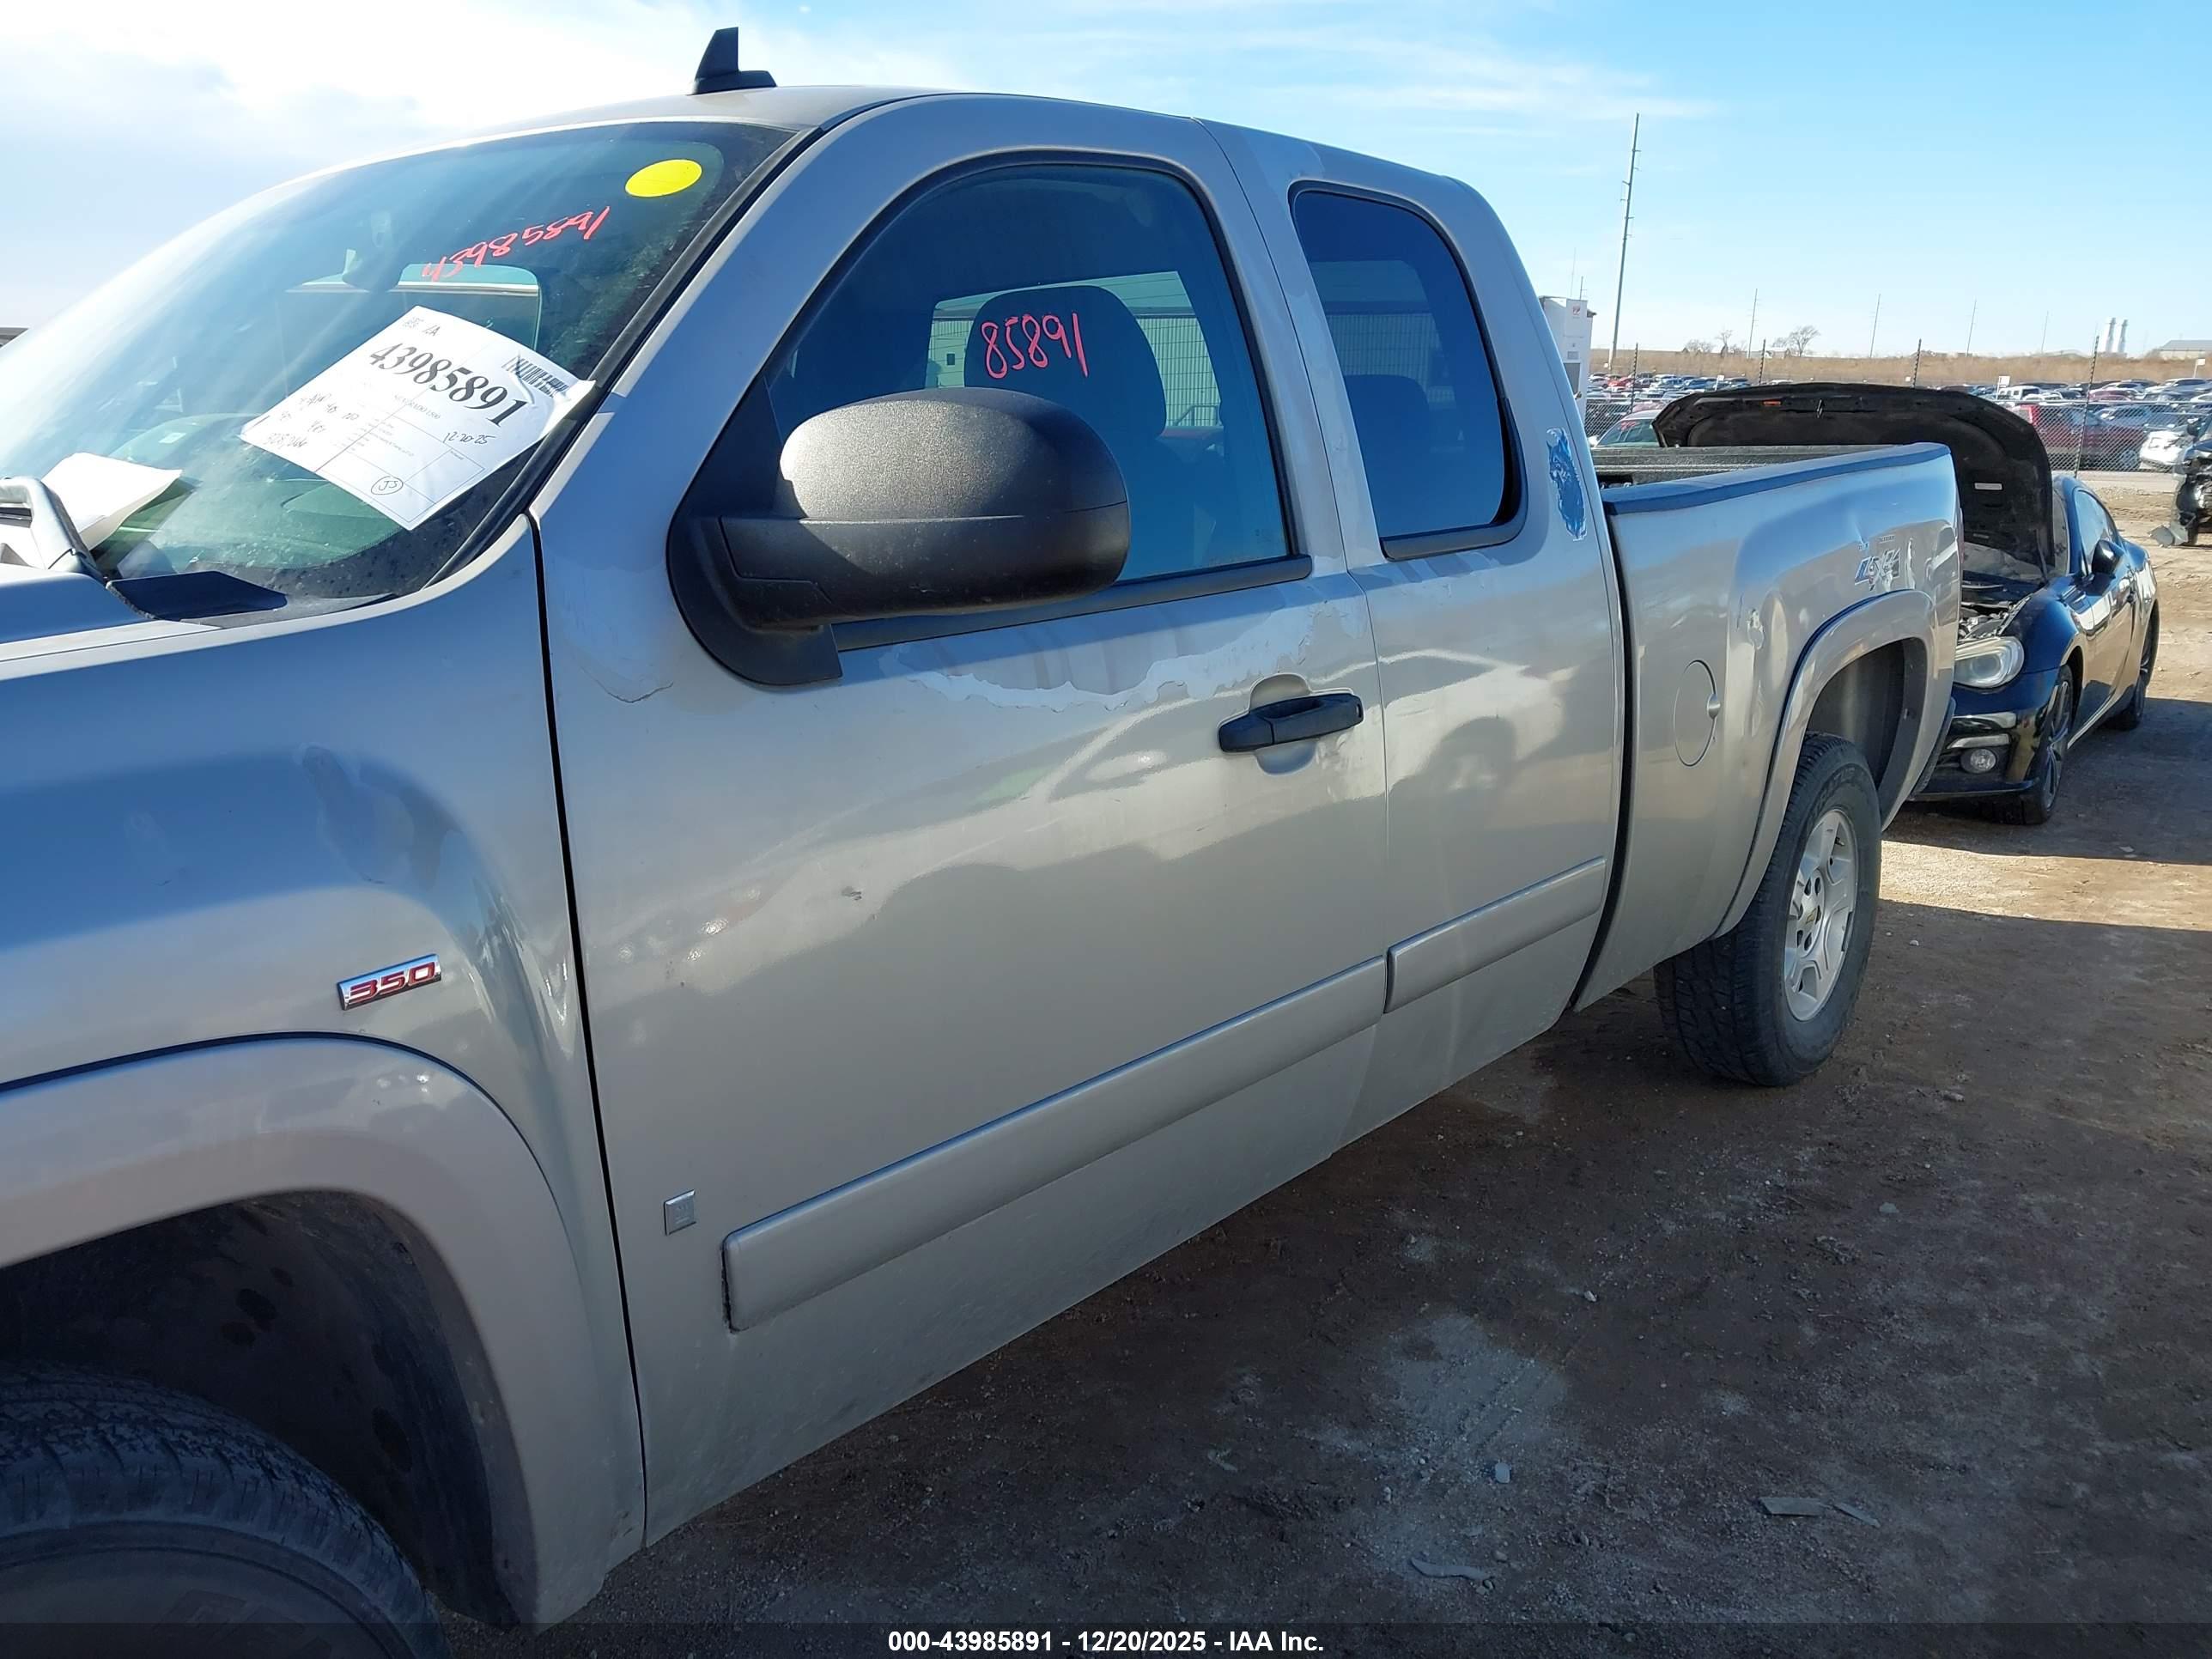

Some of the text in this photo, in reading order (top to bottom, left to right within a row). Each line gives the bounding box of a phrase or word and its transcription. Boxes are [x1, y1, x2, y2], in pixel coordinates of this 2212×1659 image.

[422, 205, 611, 282] 43985891
[981, 313, 1089, 379] 85891
[369, 343, 528, 428] 43985891
[348, 961, 435, 1004] 350
